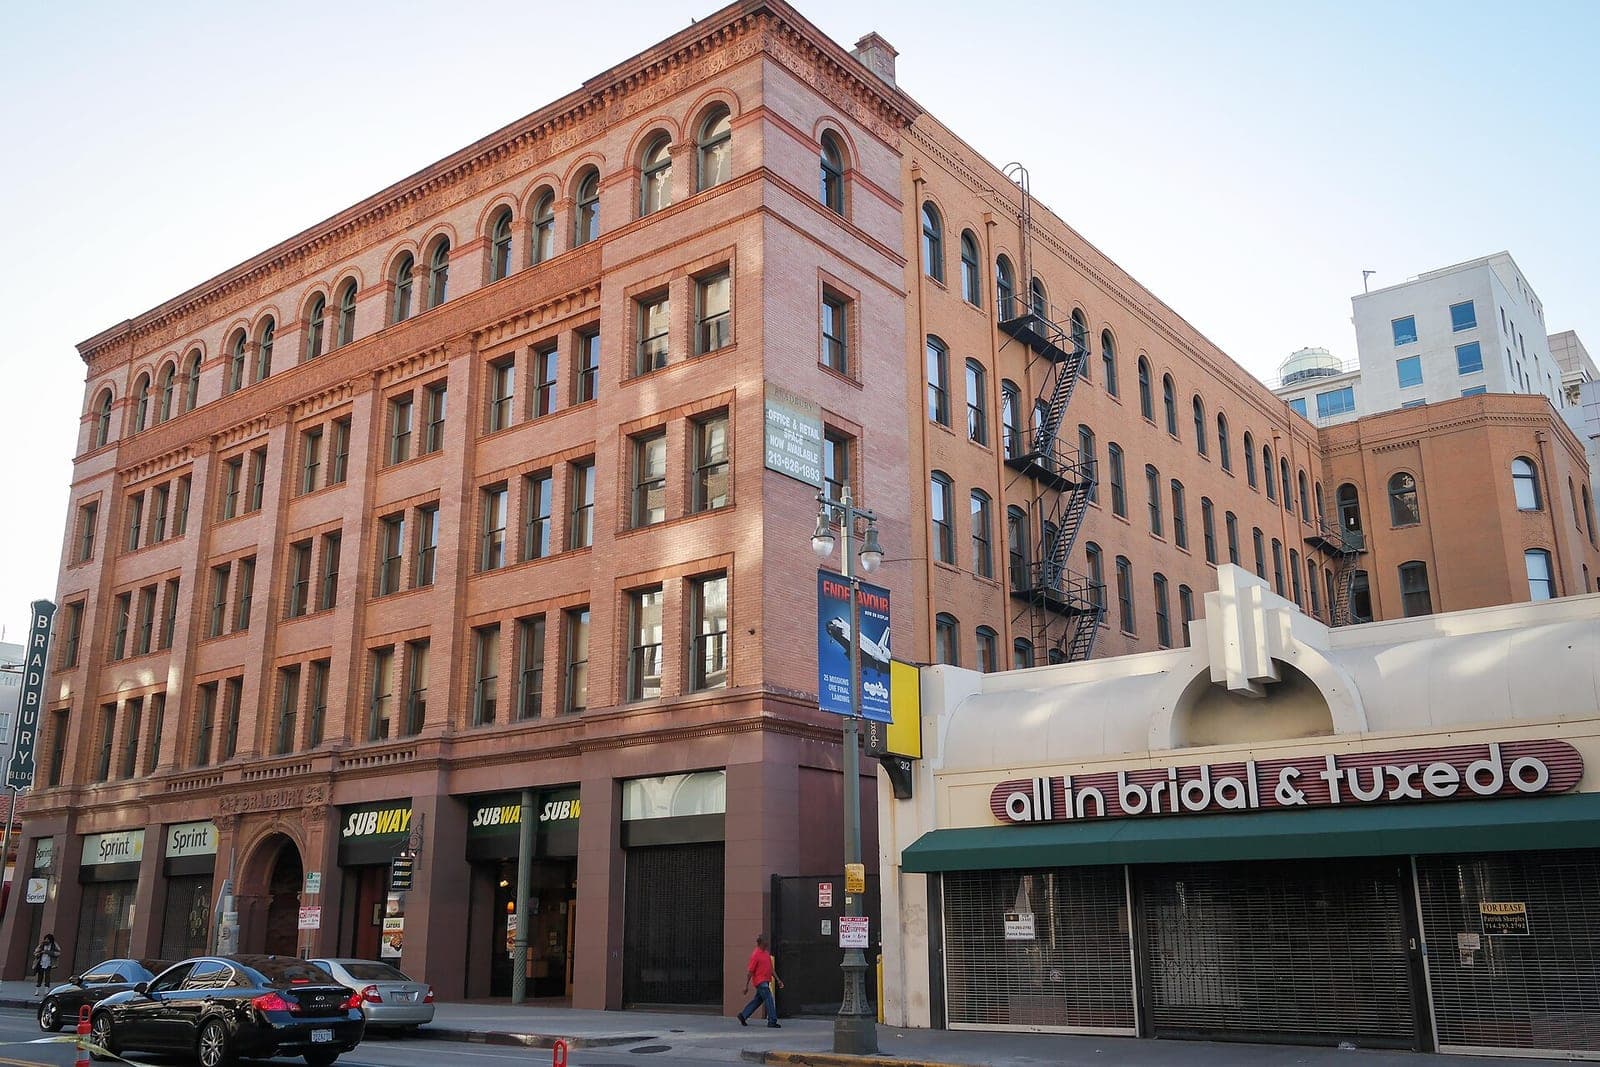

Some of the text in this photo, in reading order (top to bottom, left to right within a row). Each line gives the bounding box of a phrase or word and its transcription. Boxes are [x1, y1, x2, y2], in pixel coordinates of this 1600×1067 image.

[768, 409, 820, 440] OFFICE & RETAIL
[783, 428, 804, 445] SPACE
[769, 433, 819, 464] NOW AVAILABLE
[18, 614, 49, 766] BRADBURY
[870, 719, 879, 748] uxedo
[9, 770, 34, 781] BLDG
[1005, 742, 1550, 823] all in bridal & tuxedo
[242, 788, 304, 811] BRADBURY
[539, 799, 581, 822] SUBW
[342, 808, 413, 838] SUBWAY
[472, 805, 522, 827] SUBWA
[99, 837, 130, 862] Sprint
[172, 828, 208, 853] Sprint
[27, 893, 46, 901] Sprint
[1482, 903, 1523, 912] FOR LEASE
